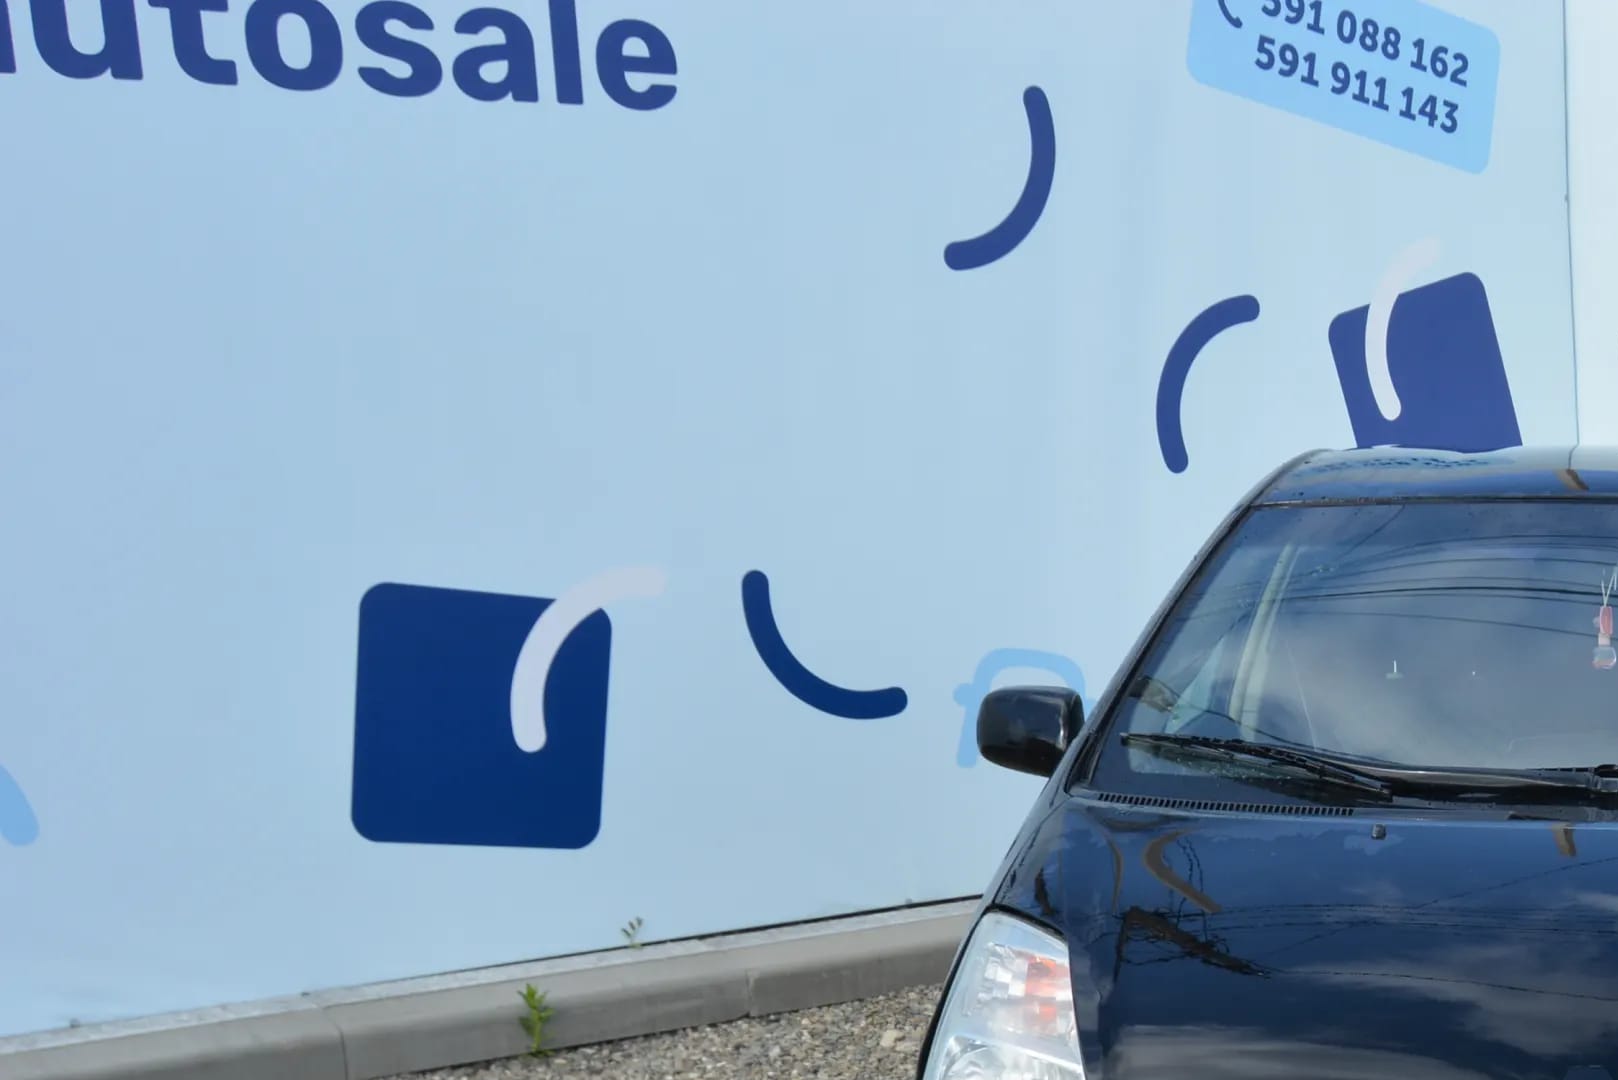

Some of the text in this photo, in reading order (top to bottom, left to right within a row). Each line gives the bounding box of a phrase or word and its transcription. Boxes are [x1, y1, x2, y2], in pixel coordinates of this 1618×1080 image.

[0, 0, 678, 111] utosale
[1254, 34, 1459, 134] 591 911 143
[1336, 10, 1401, 60] 088
[1410, 38, 1469, 87] 162
